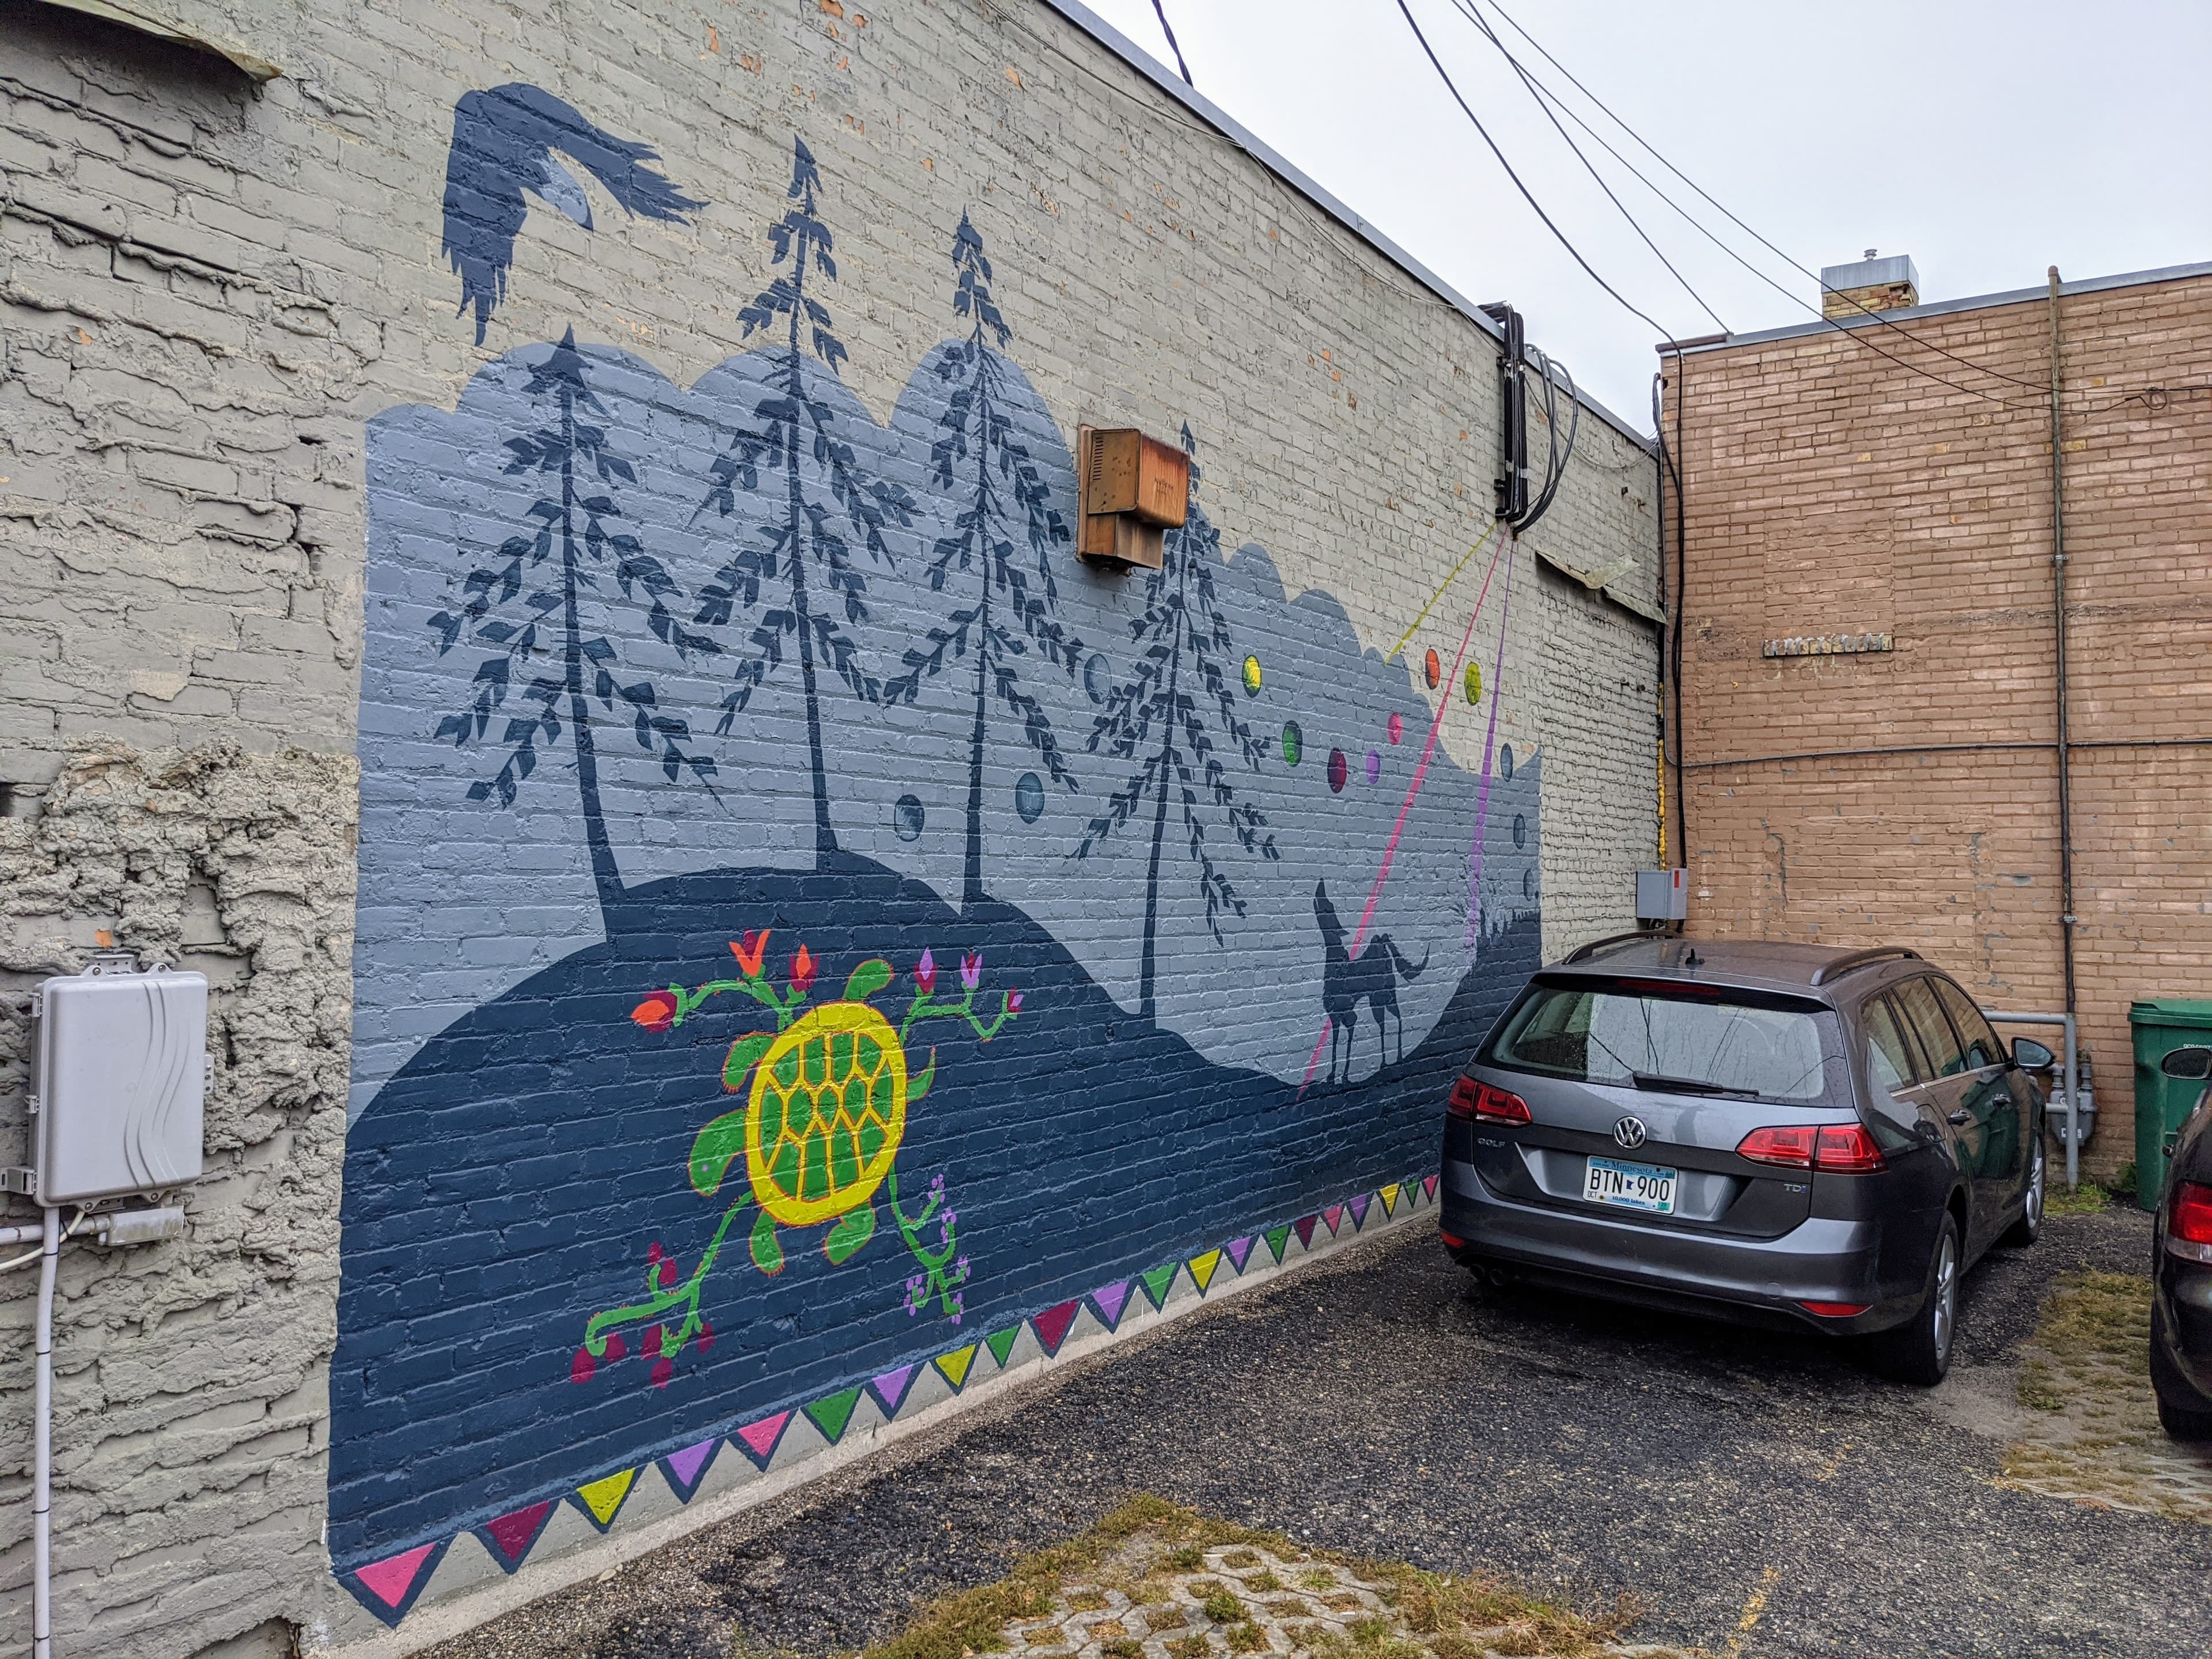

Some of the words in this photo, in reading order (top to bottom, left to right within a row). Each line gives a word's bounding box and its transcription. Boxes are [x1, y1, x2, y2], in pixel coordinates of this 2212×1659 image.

[1478, 1138, 1505, 1147] GOLF
[1611, 1161, 1653, 1174] Minnesota
[1590, 1169, 1623, 1194] BTN
[1637, 1176, 1669, 1201] 900
[1783, 1183, 1806, 1193] TDI
